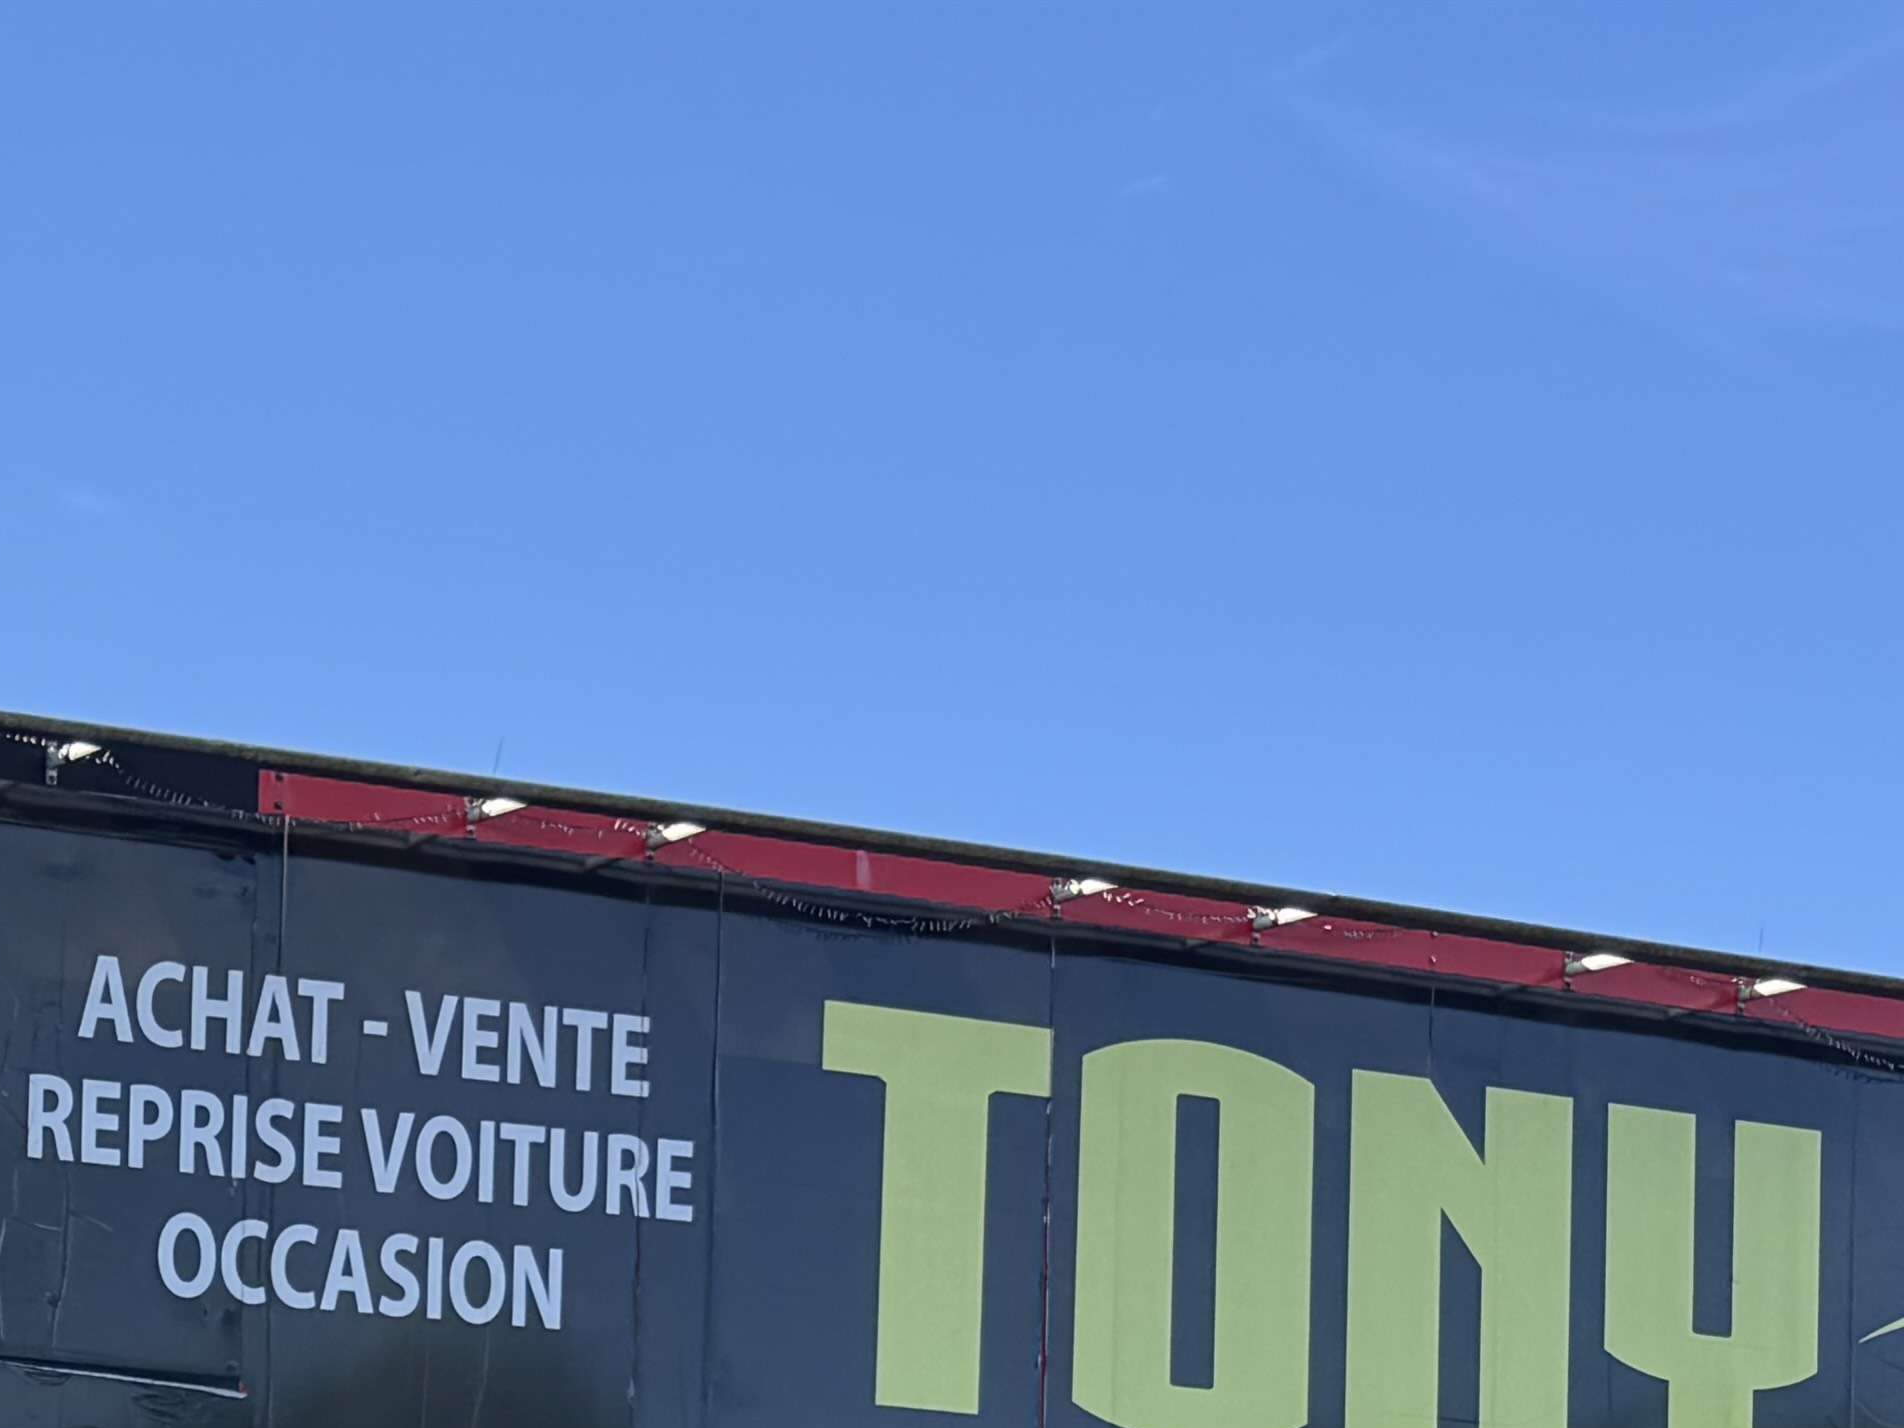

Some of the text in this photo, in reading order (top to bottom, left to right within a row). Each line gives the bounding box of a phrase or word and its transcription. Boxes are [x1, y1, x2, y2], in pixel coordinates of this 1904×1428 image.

[77, 955, 345, 1065] ACHAT
[405, 989, 652, 1098] VENTE
[27, 1072, 695, 1223] REPRISE VOITURE
[157, 1210, 564, 1331] OCCASION
